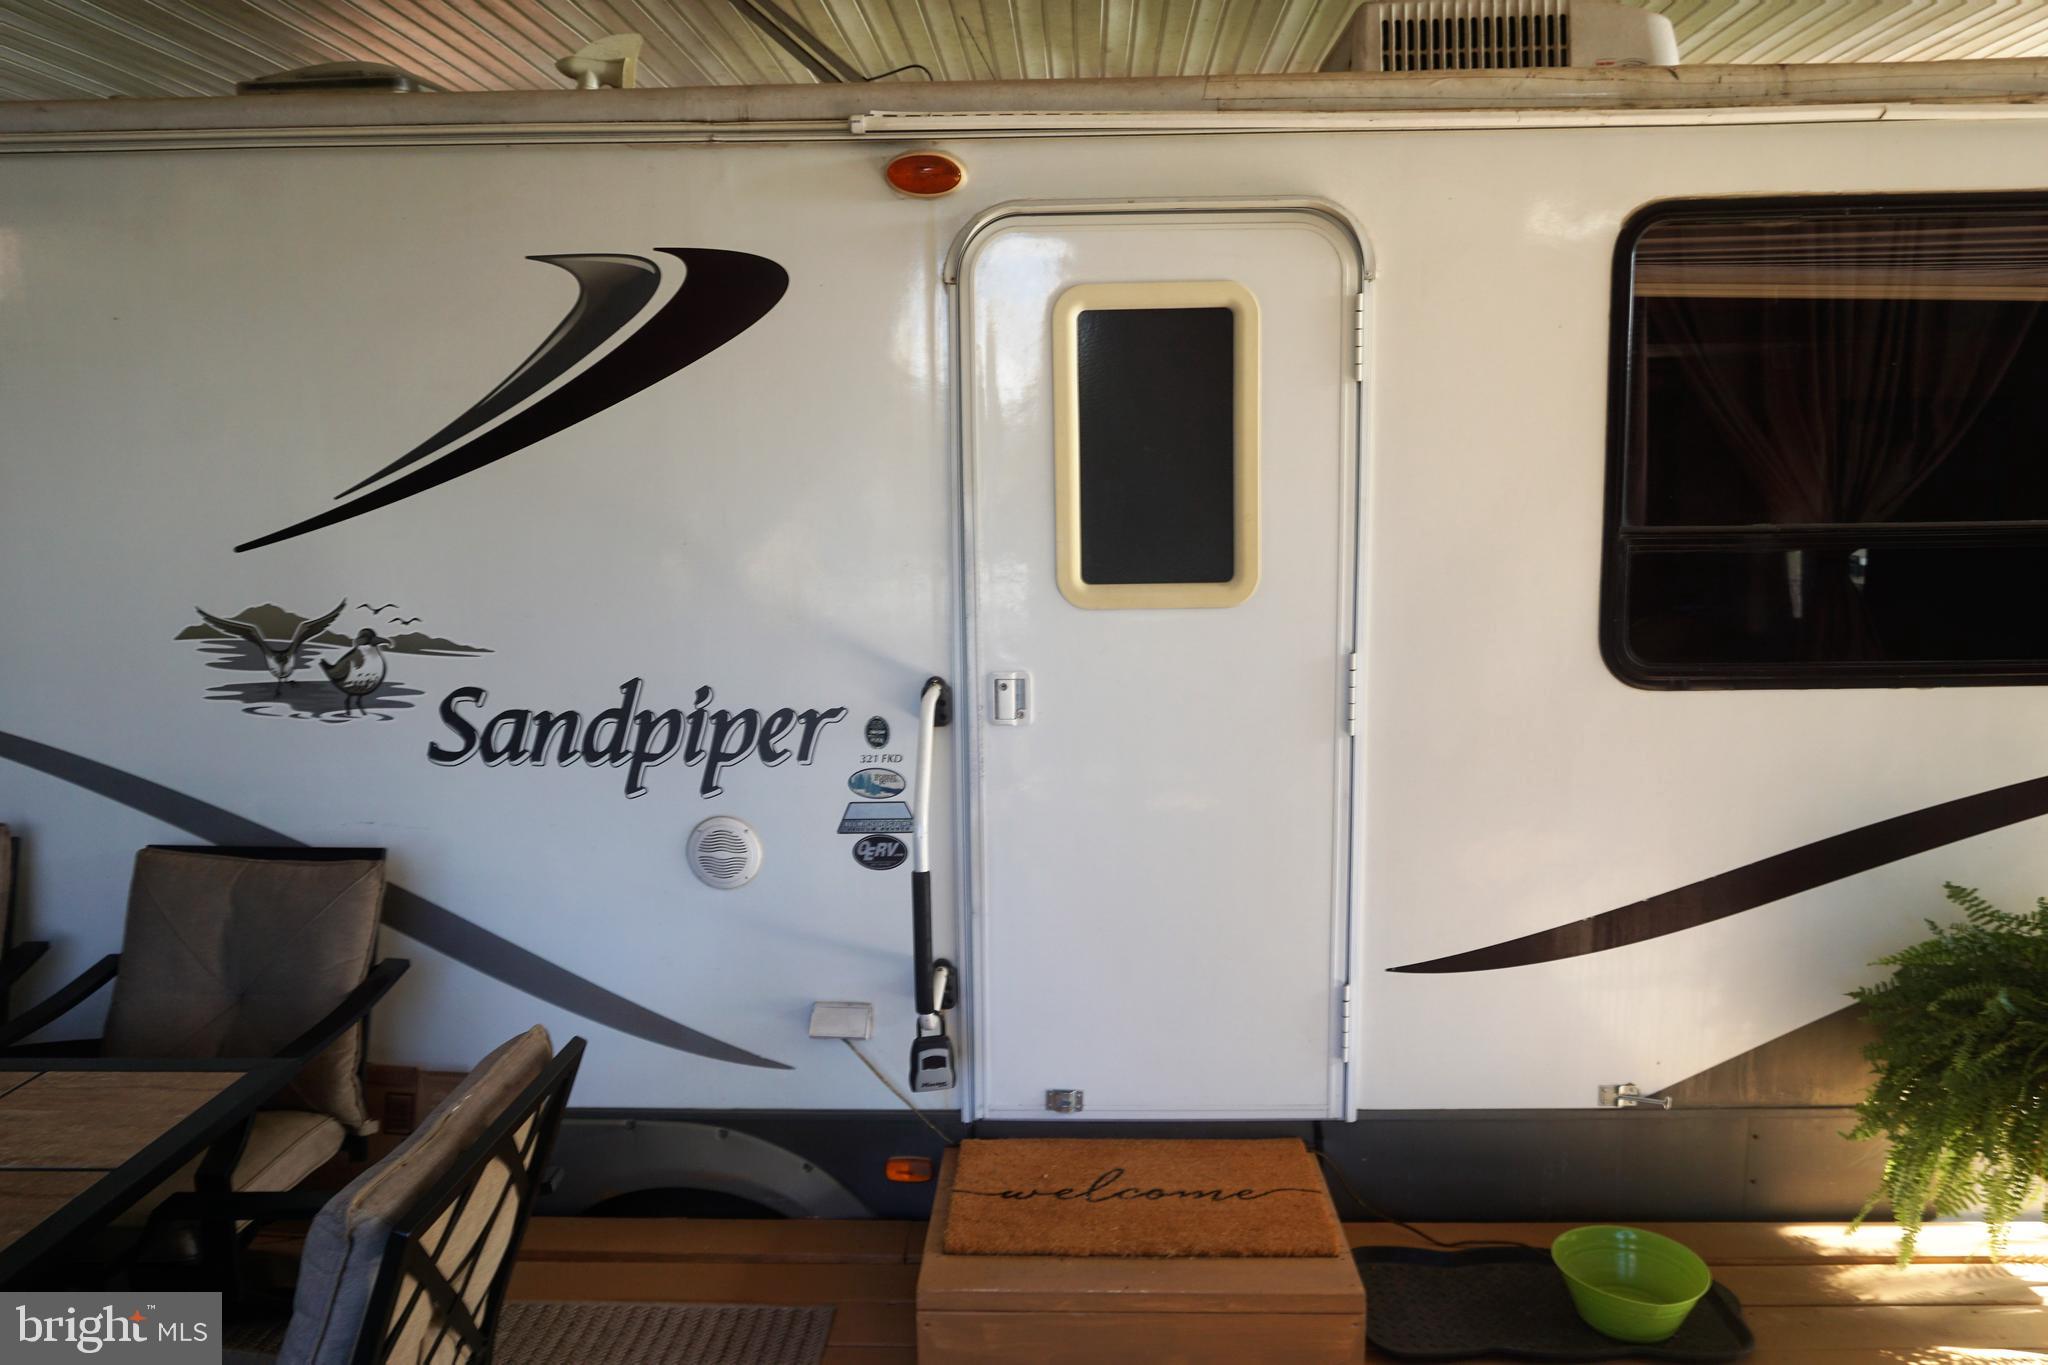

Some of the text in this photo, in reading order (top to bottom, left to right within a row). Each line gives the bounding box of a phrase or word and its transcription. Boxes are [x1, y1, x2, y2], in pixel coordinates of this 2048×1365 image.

[427, 677, 848, 799] Sandpiper
[859, 753, 903, 764] 321 FKD
[951, 1168, 1322, 1202] welcome
